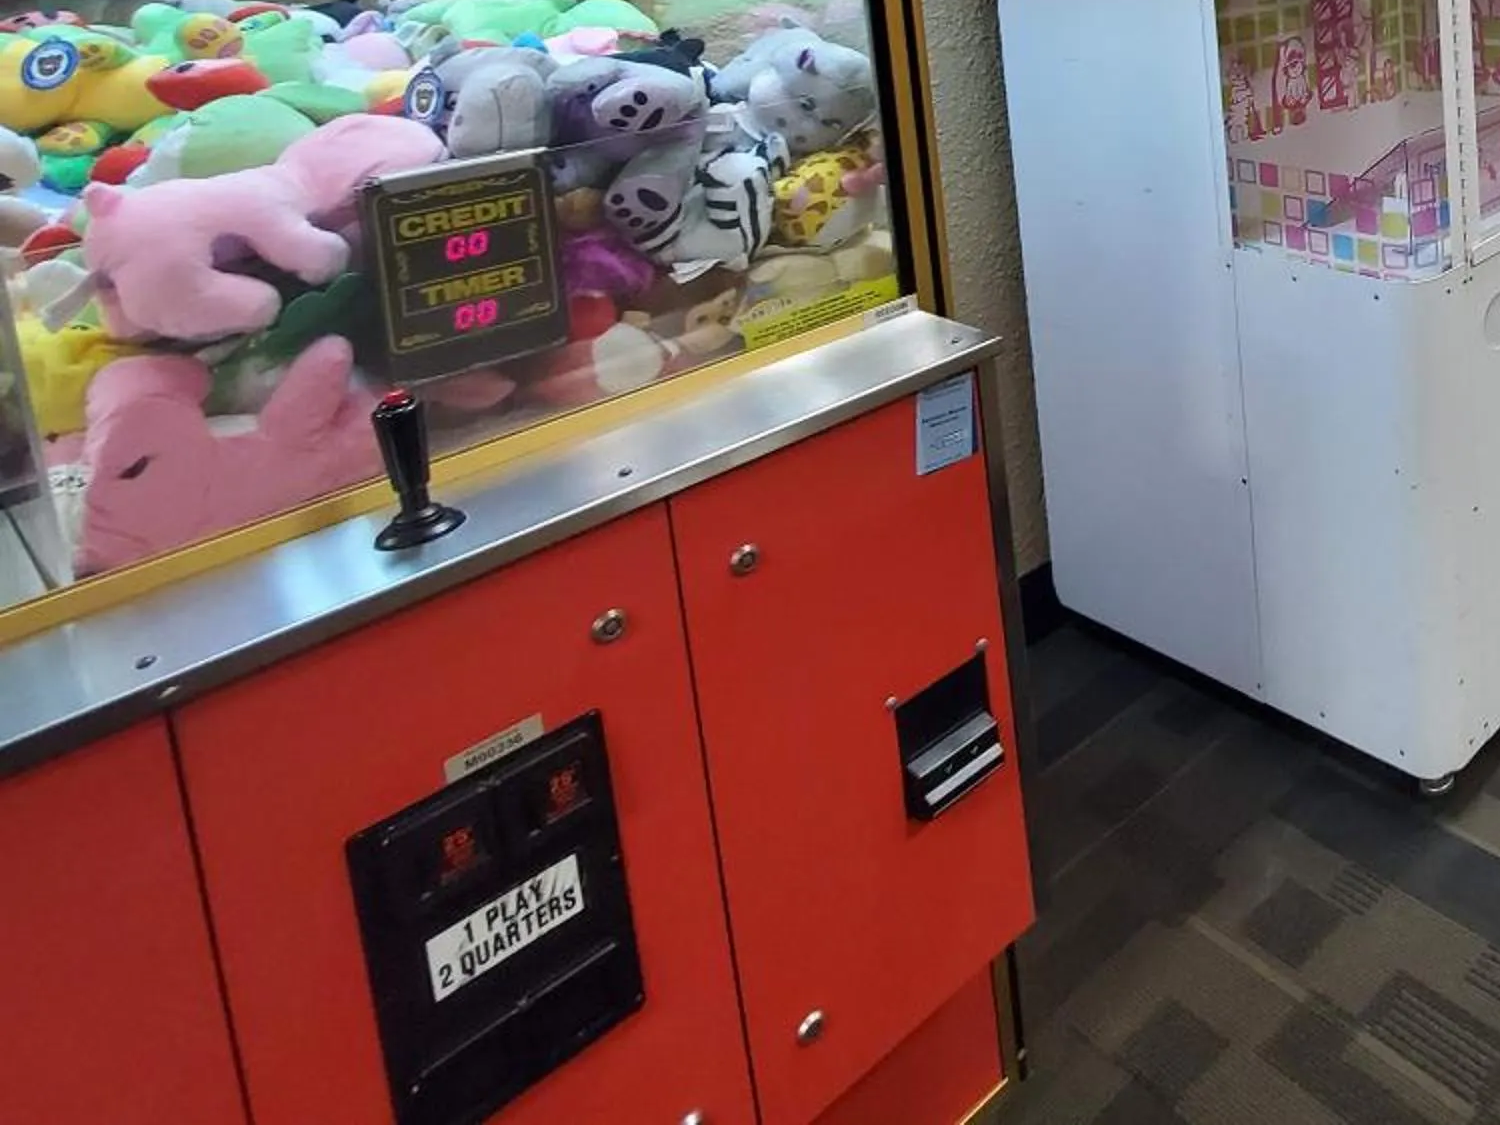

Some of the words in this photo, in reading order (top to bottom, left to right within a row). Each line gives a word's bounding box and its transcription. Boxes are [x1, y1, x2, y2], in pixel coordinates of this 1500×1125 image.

[399, 195, 526, 238] CREDIT
[419, 265, 526, 306] TIMER
[439, 962, 454, 990] 2
[460, 886, 577, 976] QUARTERS
[463, 918, 474, 944] 1
[485, 877, 543, 932] PLAY
